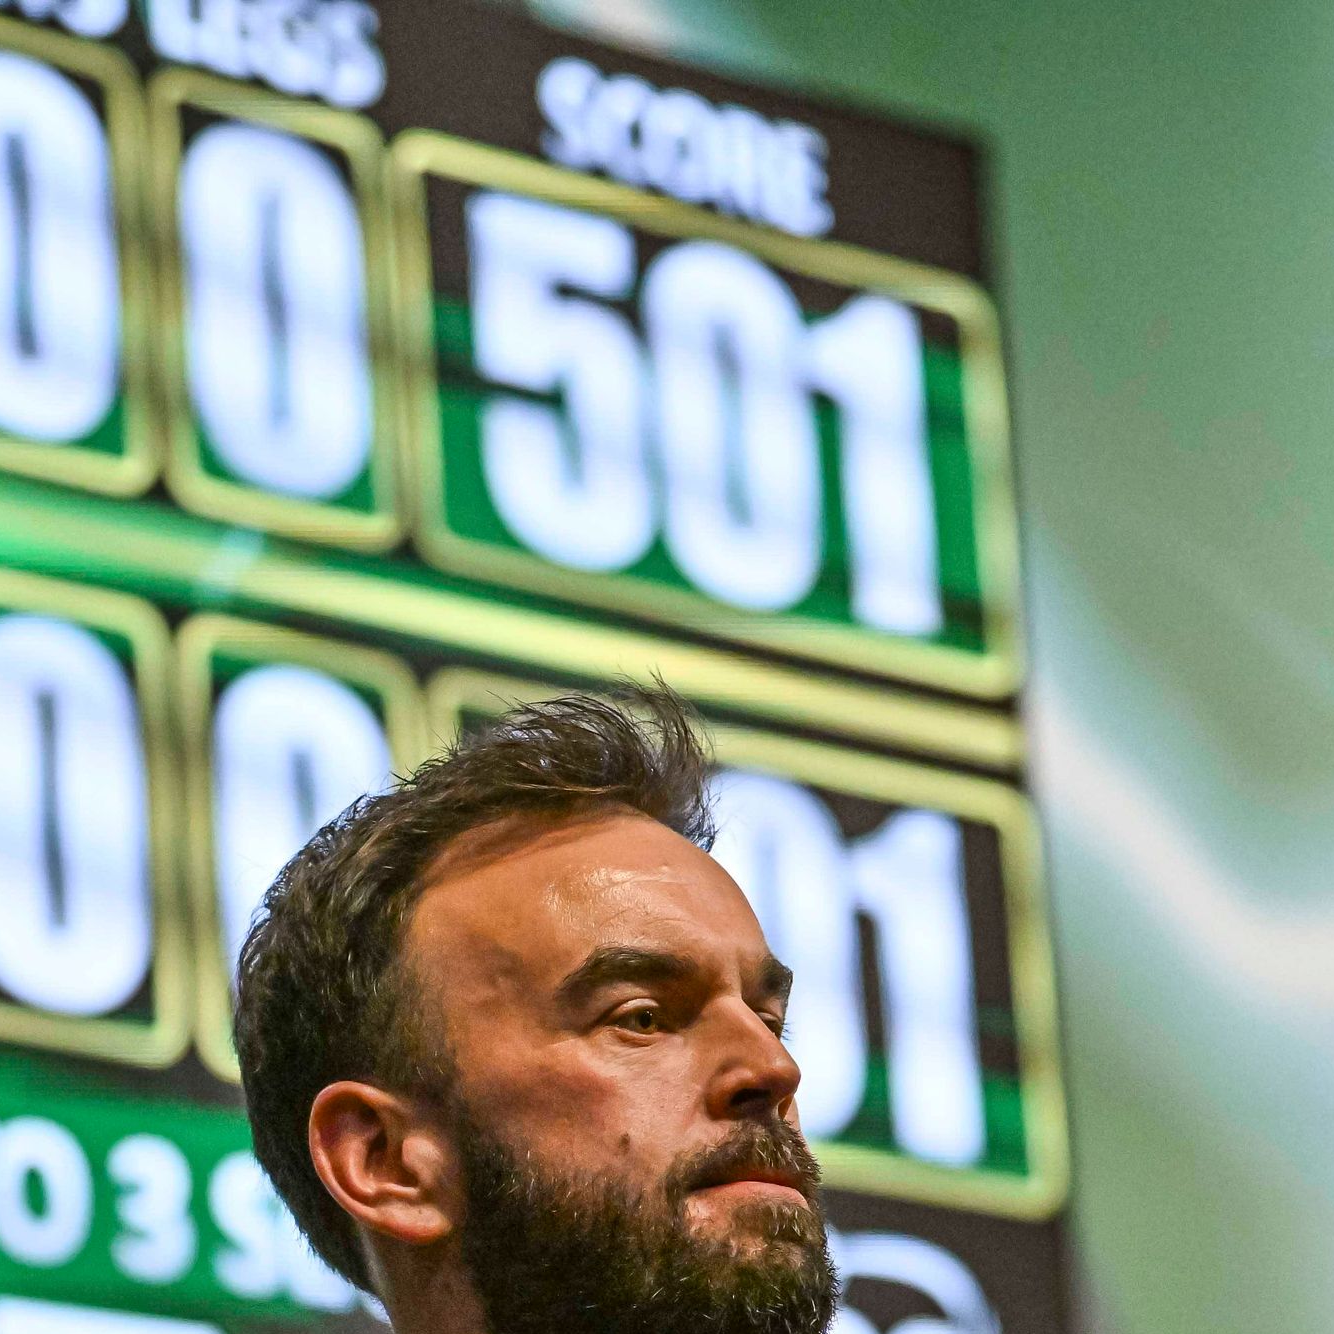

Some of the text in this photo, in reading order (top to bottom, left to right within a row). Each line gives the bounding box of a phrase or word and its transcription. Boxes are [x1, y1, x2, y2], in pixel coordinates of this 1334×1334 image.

[536, 56, 835, 239] SCORE
[177, 119, 375, 501] 0
[466, 190, 944, 638] 501
[107, 1132, 199, 1285] 3
